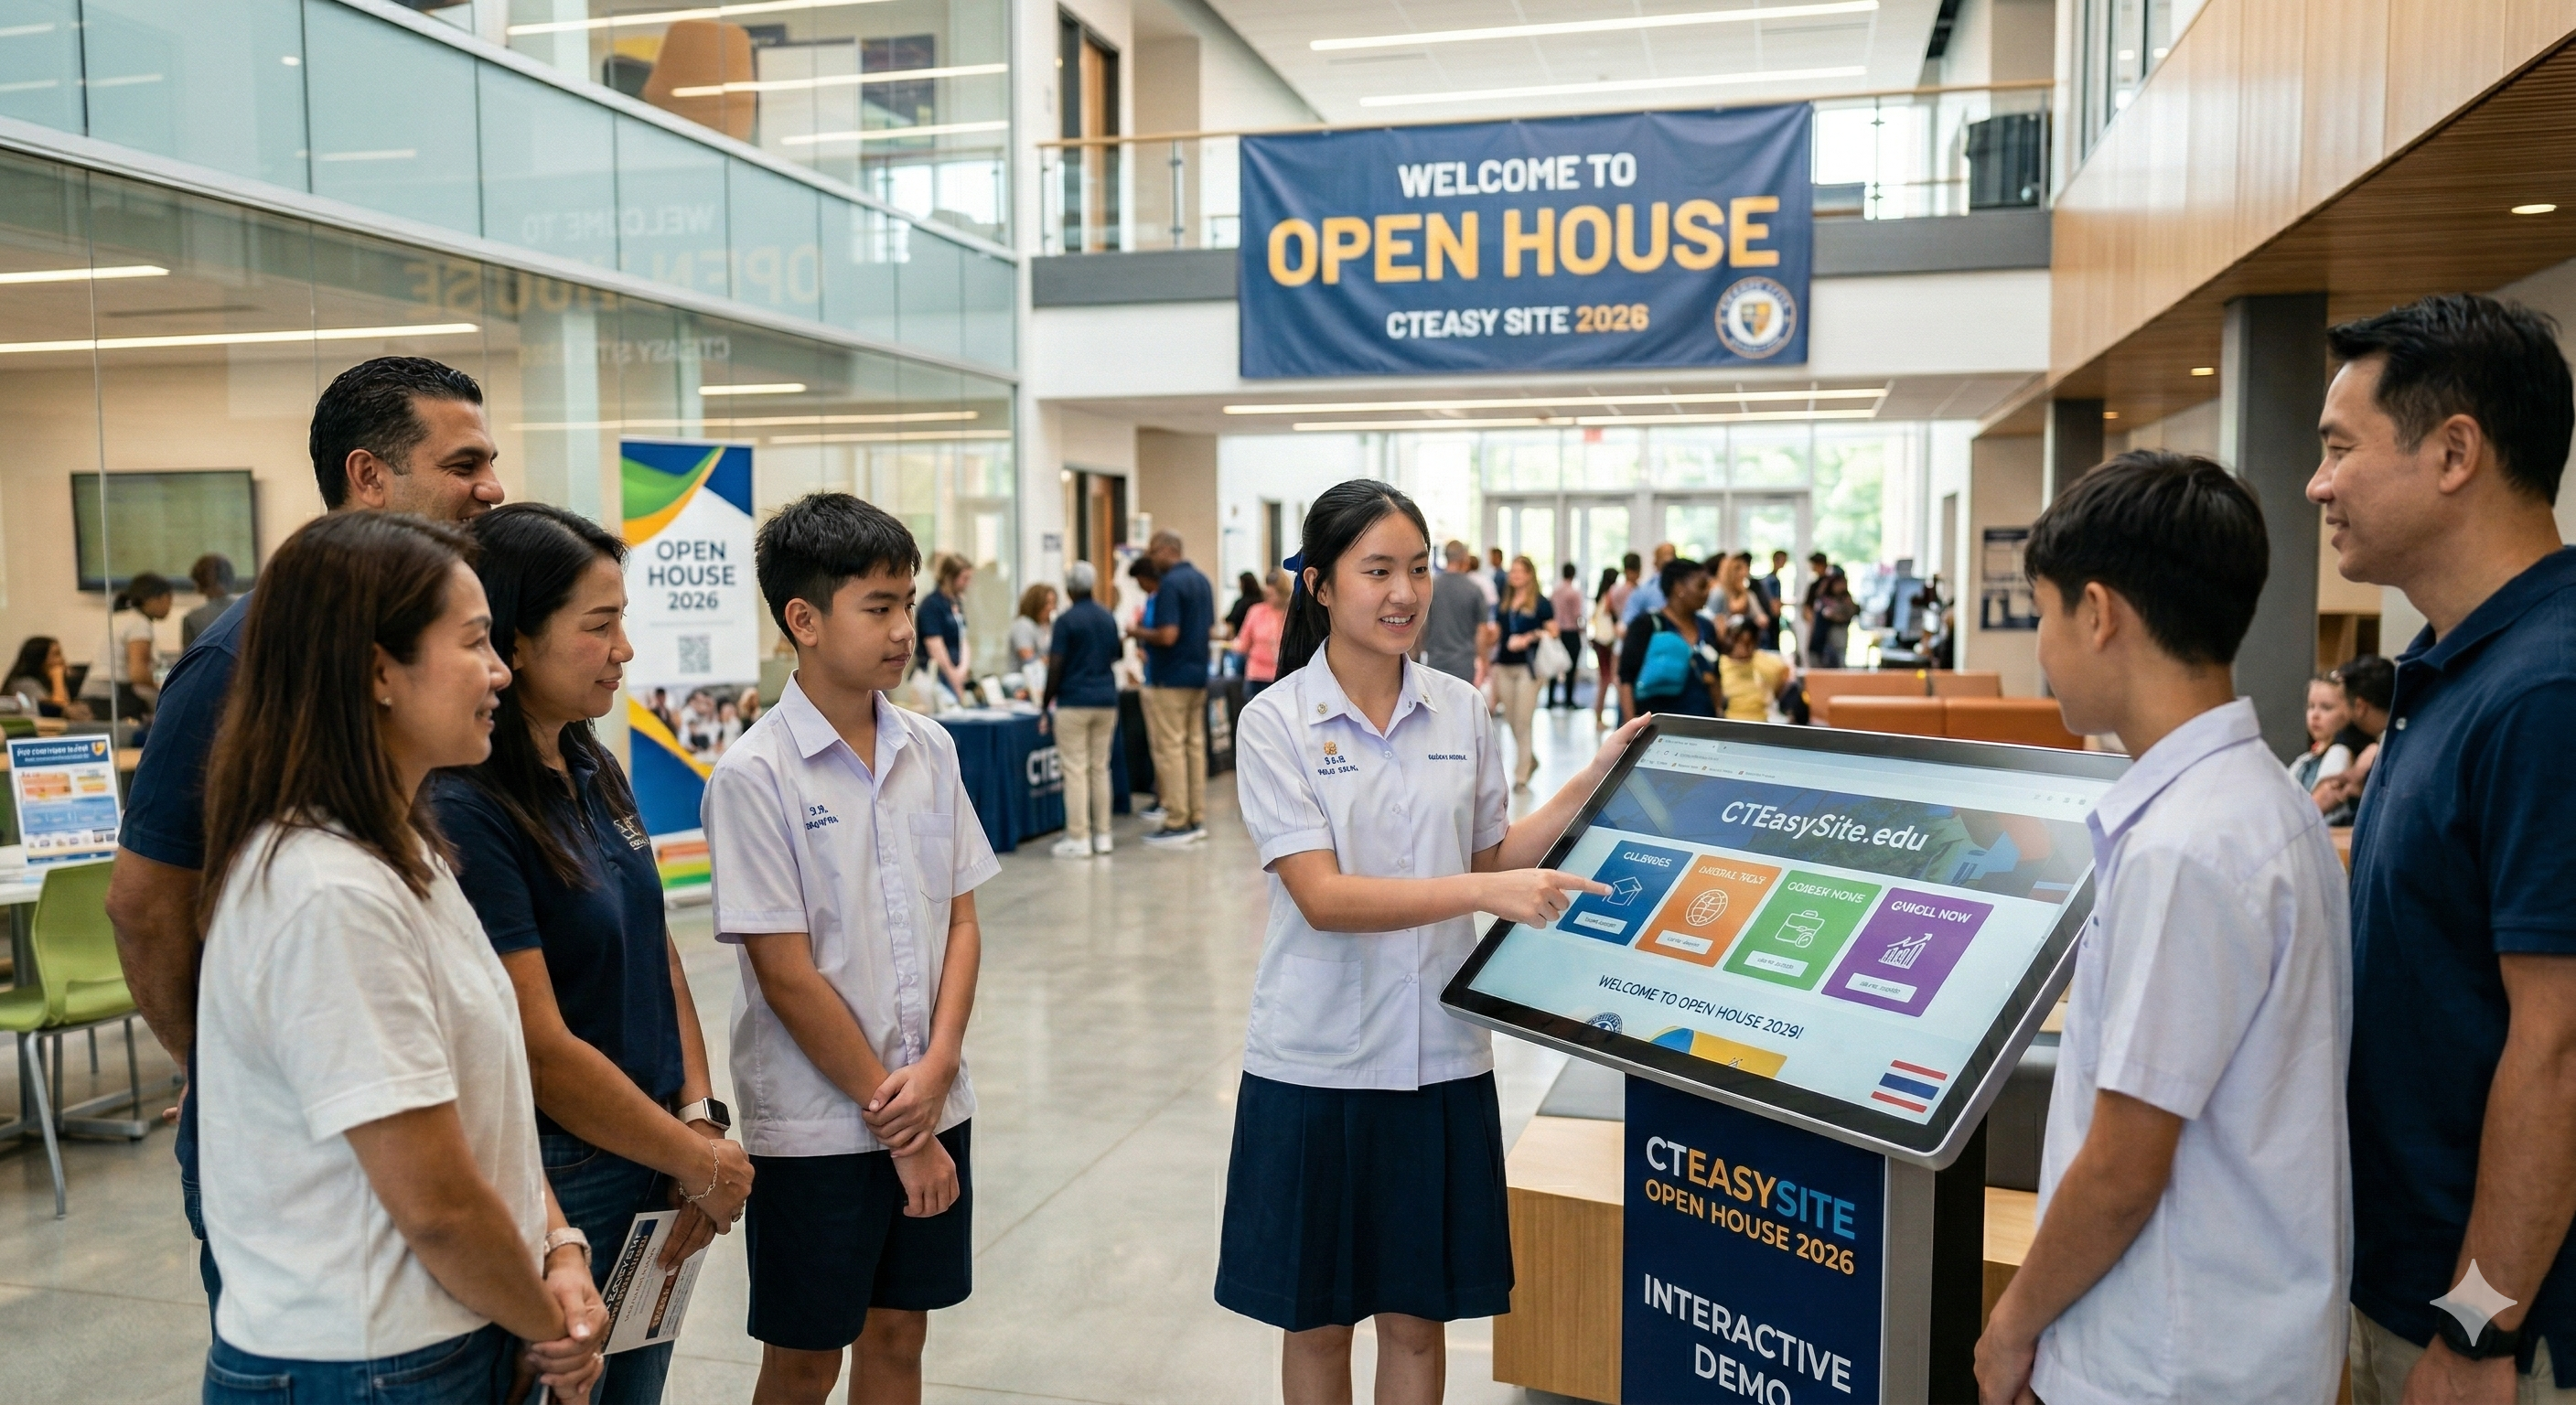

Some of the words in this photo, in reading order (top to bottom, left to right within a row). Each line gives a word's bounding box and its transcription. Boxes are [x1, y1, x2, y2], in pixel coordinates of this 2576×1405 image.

[1398, 156, 1582, 198] WELCOME
[1586, 152, 1638, 188] TO
[1268, 210, 1479, 286] OPEN
[1503, 196, 1780, 278] HOUSE
[1386, 309, 1498, 340] CTEASY
[1503, 306, 1570, 337] SITE
[1575, 303, 1649, 334] 2026
[648, 564, 736, 587] HOUSE
[655, 540, 726, 562] OPEN
[667, 591, 720, 611] 2026
[1722, 800, 1930, 852] CTEasySite.edu
[1937, 908, 1973, 924] NOW
[1598, 974, 1658, 1001] WELCOME
[1661, 992, 1678, 1005] TO
[1678, 996, 1716, 1016] OPEN
[1715, 1005, 1765, 1029] HOUSE
[1646, 1135, 1856, 1240] CTEASYSITE
[1645, 1178, 1705, 1219] OPEN
[1711, 1201, 1790, 1252] HOUSE
[1796, 1232, 1855, 1275] 2026
[1644, 1273, 1852, 1394] INTERACTIVE
[1694, 1343, 1791, 1405] DEMO
